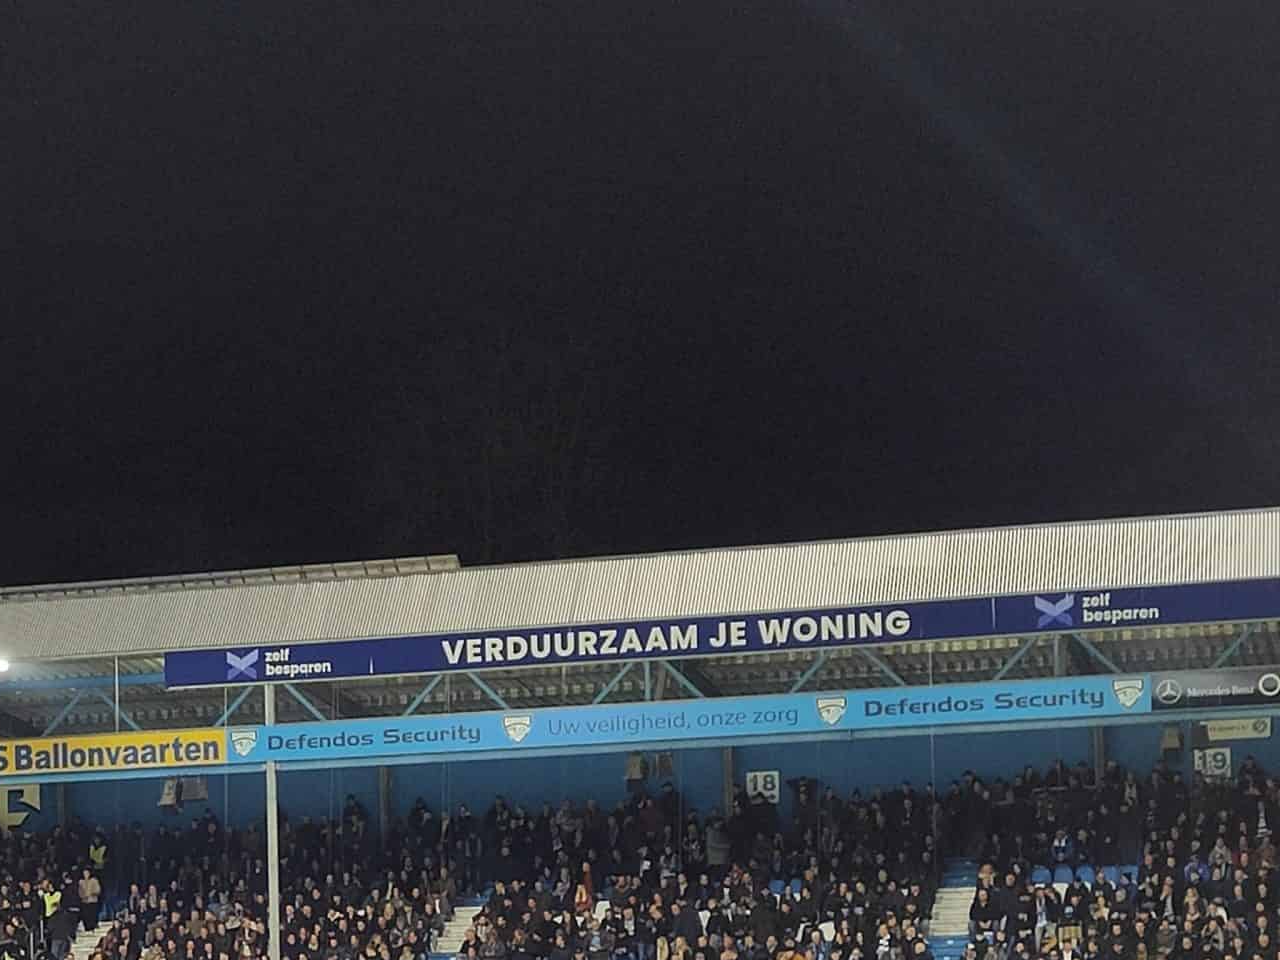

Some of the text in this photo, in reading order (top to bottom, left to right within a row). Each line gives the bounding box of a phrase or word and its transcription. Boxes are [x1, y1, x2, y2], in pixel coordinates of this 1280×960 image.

[1082, 605, 1160, 625] besparen
[441, 610, 912, 664] VERDUURZAAM JE WONING
[265, 661, 332, 678] besparen
[864, 688, 1105, 717] Defendos Security
[548, 708, 799, 737] Uw veiligheid, onze zorg
[267, 723, 481, 751] Defendos Security
[14, 737, 219, 770] Ballonvaarten
[750, 774, 777, 791] 18
